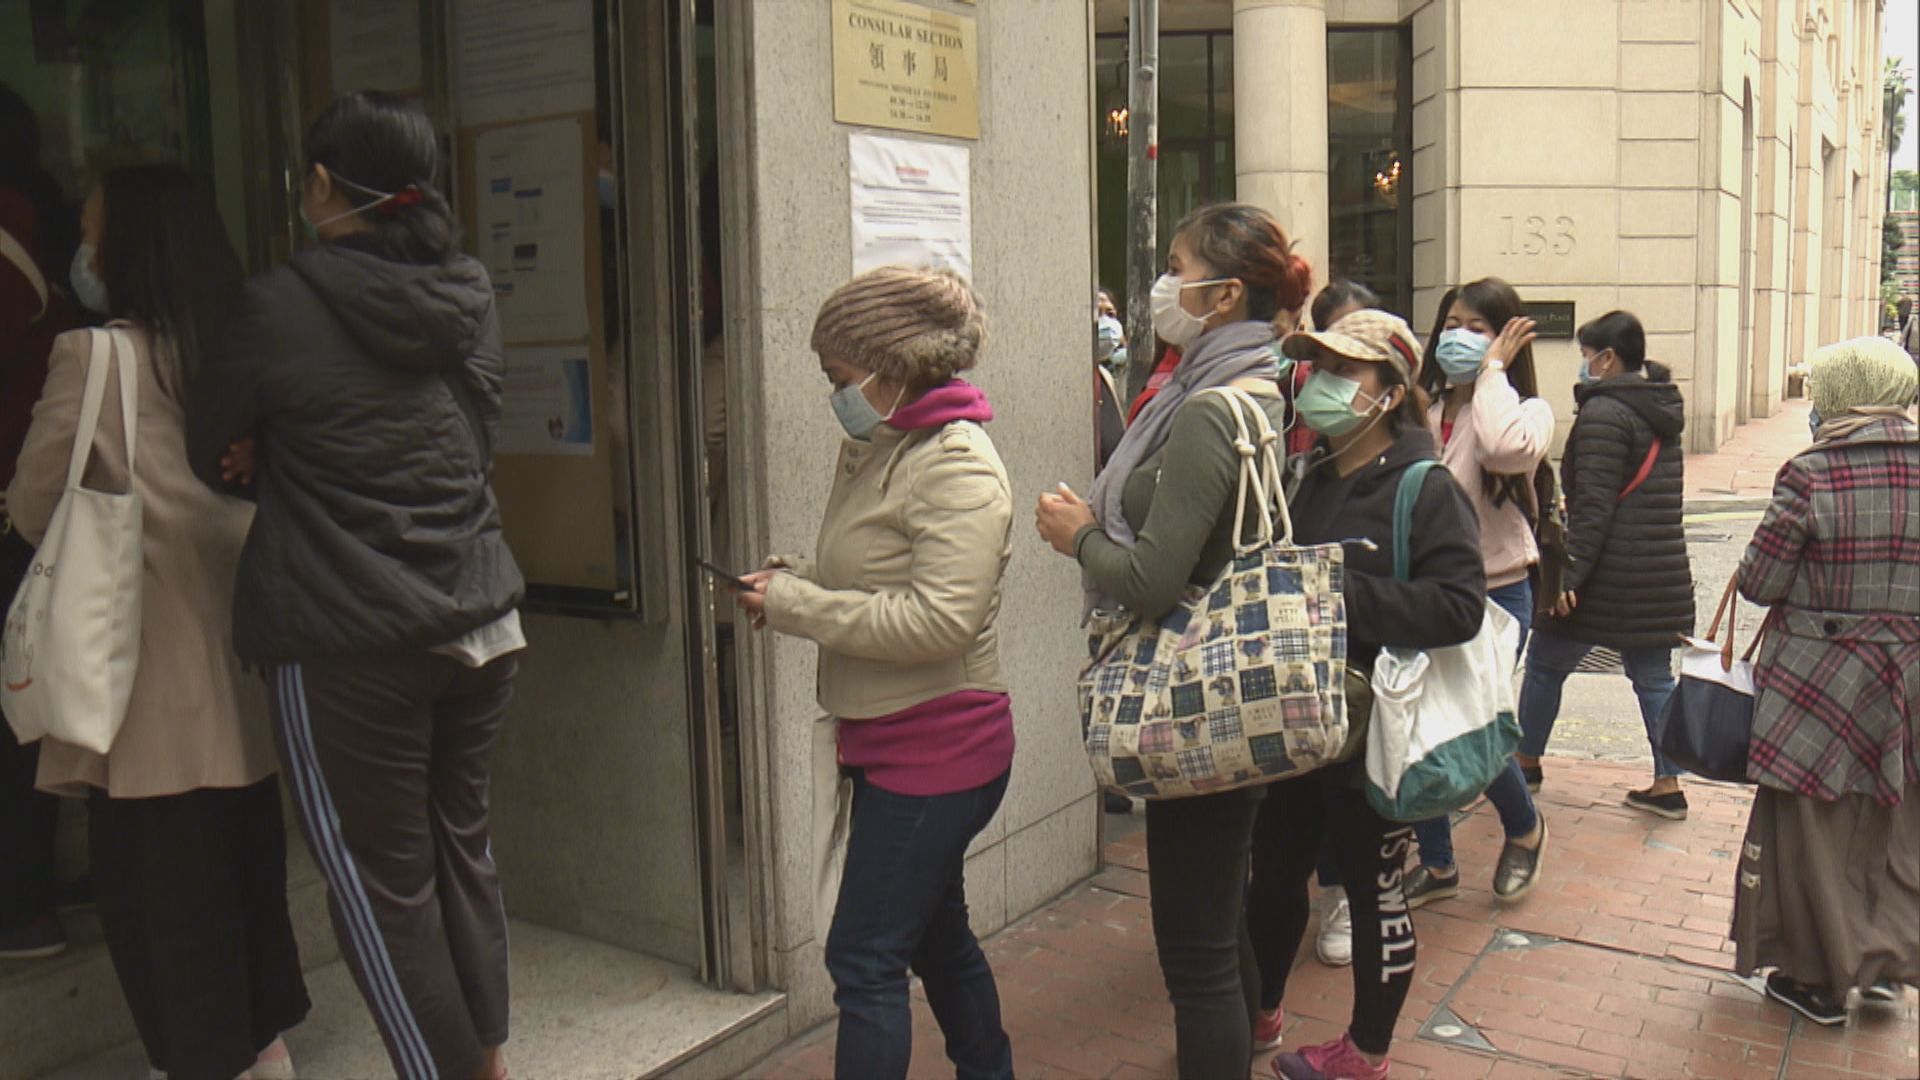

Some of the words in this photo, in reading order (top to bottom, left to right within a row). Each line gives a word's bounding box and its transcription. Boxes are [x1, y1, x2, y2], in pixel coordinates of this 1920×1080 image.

[849, 12, 912, 39] CONSULAR
[916, 28, 963, 49] SECTION
[1499, 215, 1577, 256] 133
[1377, 868, 1417, 984] SWELL
